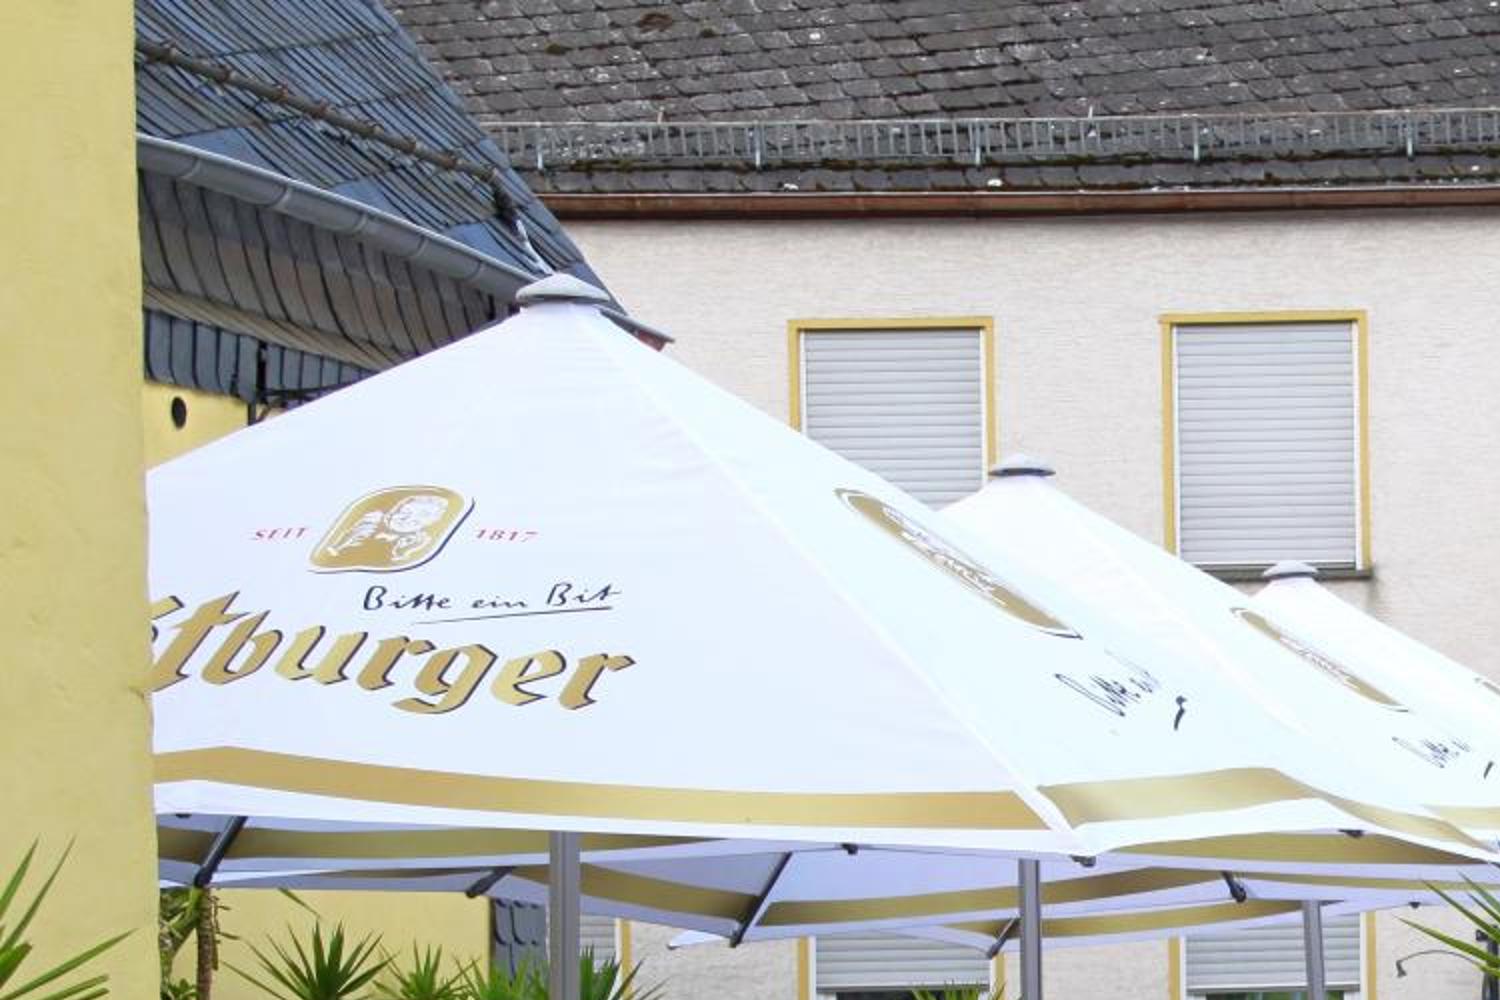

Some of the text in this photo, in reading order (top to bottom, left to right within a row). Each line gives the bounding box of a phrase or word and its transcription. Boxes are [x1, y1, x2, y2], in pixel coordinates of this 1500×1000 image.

[253, 526, 539, 542] SEIT 1817
[363, 582, 622, 612] Bitte ein Bit
[150, 590, 636, 715] tburger
